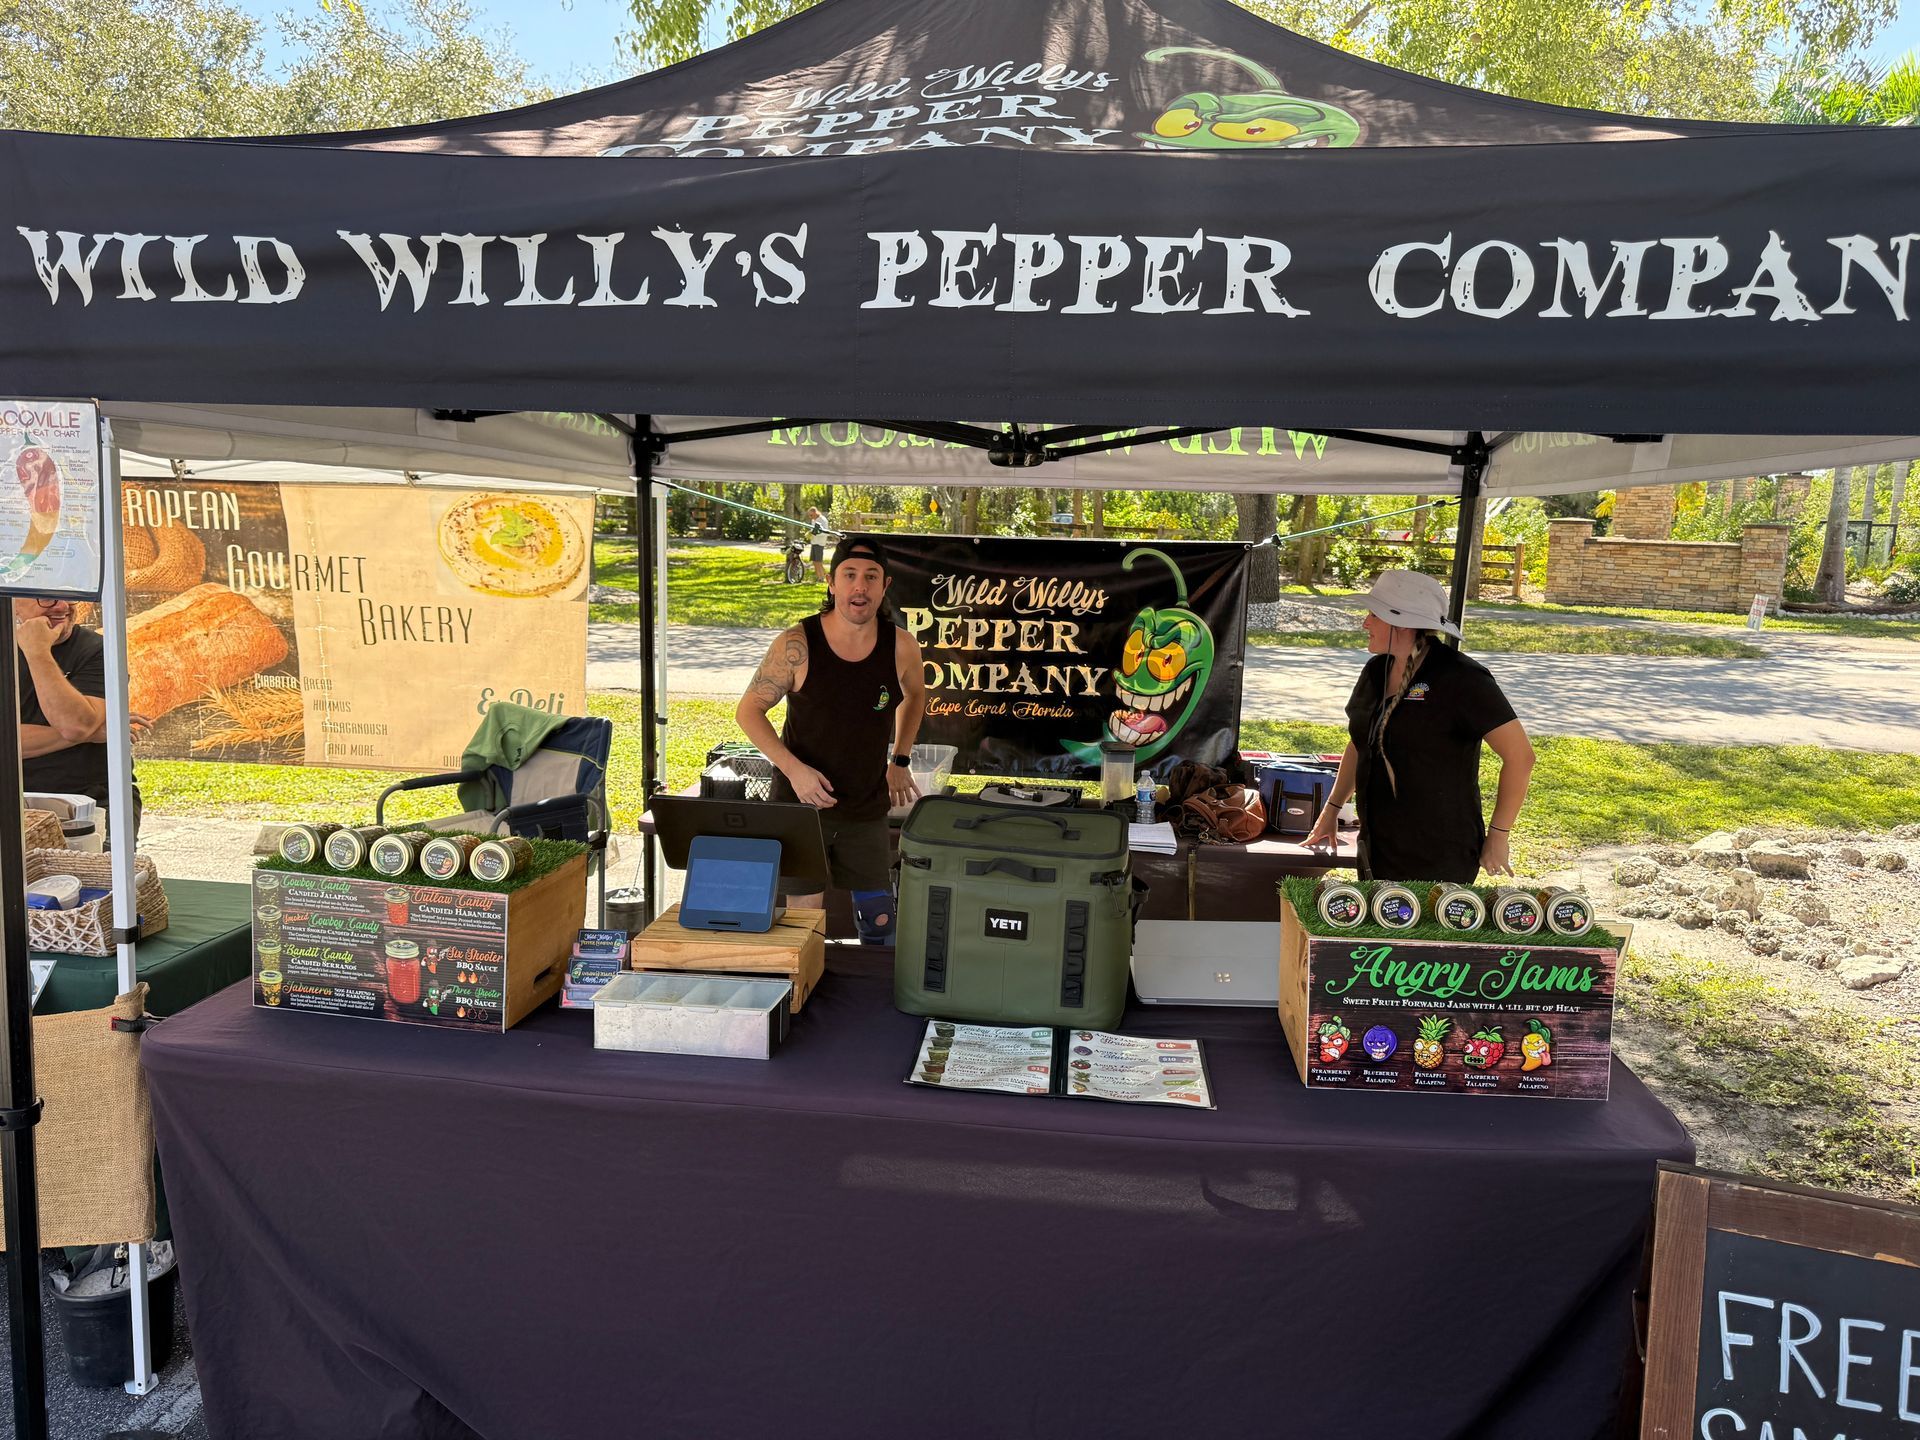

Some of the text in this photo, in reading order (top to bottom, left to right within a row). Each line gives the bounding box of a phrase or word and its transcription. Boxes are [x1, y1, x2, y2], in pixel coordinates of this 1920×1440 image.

[755, 60, 1119, 115] Wild Willys
[660, 95, 1075, 141] PEPPER
[17, 222, 1920, 323] WILD WILLY'S PEPPER COMPAN
[0, 428, 23, 436] EPPER
[54, 430, 81, 438] CHART
[126, 488, 240, 530] ROPEAN
[227, 544, 367, 594] GOURMET
[931, 573, 1110, 616] Wild Willys
[358, 598, 473, 646] BAKERY
[900, 607, 1089, 655] PEPPER
[923, 660, 1109, 697] OMPANY
[510, 689, 565, 715] Deli
[925, 696, 1075, 719] Cape Coral Florida
[328, 742, 346, 756] AND
[280, 874, 353, 894] Cowboy Candy
[288, 888, 319, 898] CANDIED
[411, 889, 494, 911] Outlaw Candy
[418, 905, 454, 915] CANDIED
[455, 908, 502, 920] HABANEROS
[308, 913, 344, 930] Cowboy
[346, 917, 382, 934] Candy
[989, 917, 1023, 931] YETI
[284, 943, 354, 964] Bandit Candy
[291, 957, 321, 967] CANDIED
[322, 961, 357, 971] SERRANOS
[447, 946, 503, 963] Six Shooter
[456, 961, 499, 973] BBQ SAUCE
[1325, 946, 1598, 1000] Angry Jams
[455, 996, 497, 1008] BBQ SAUCE
[1342, 997, 1370, 1005] SWEET
[1372, 998, 1400, 1006] FRUIT
[1401, 999, 1446, 1008] FORWARD
[1447, 1000, 1471, 1009] JAMS
[1311, 1068, 1352, 1076] STRAWBERRY
[1464, 1073, 1500, 1081] RASPBERRY
